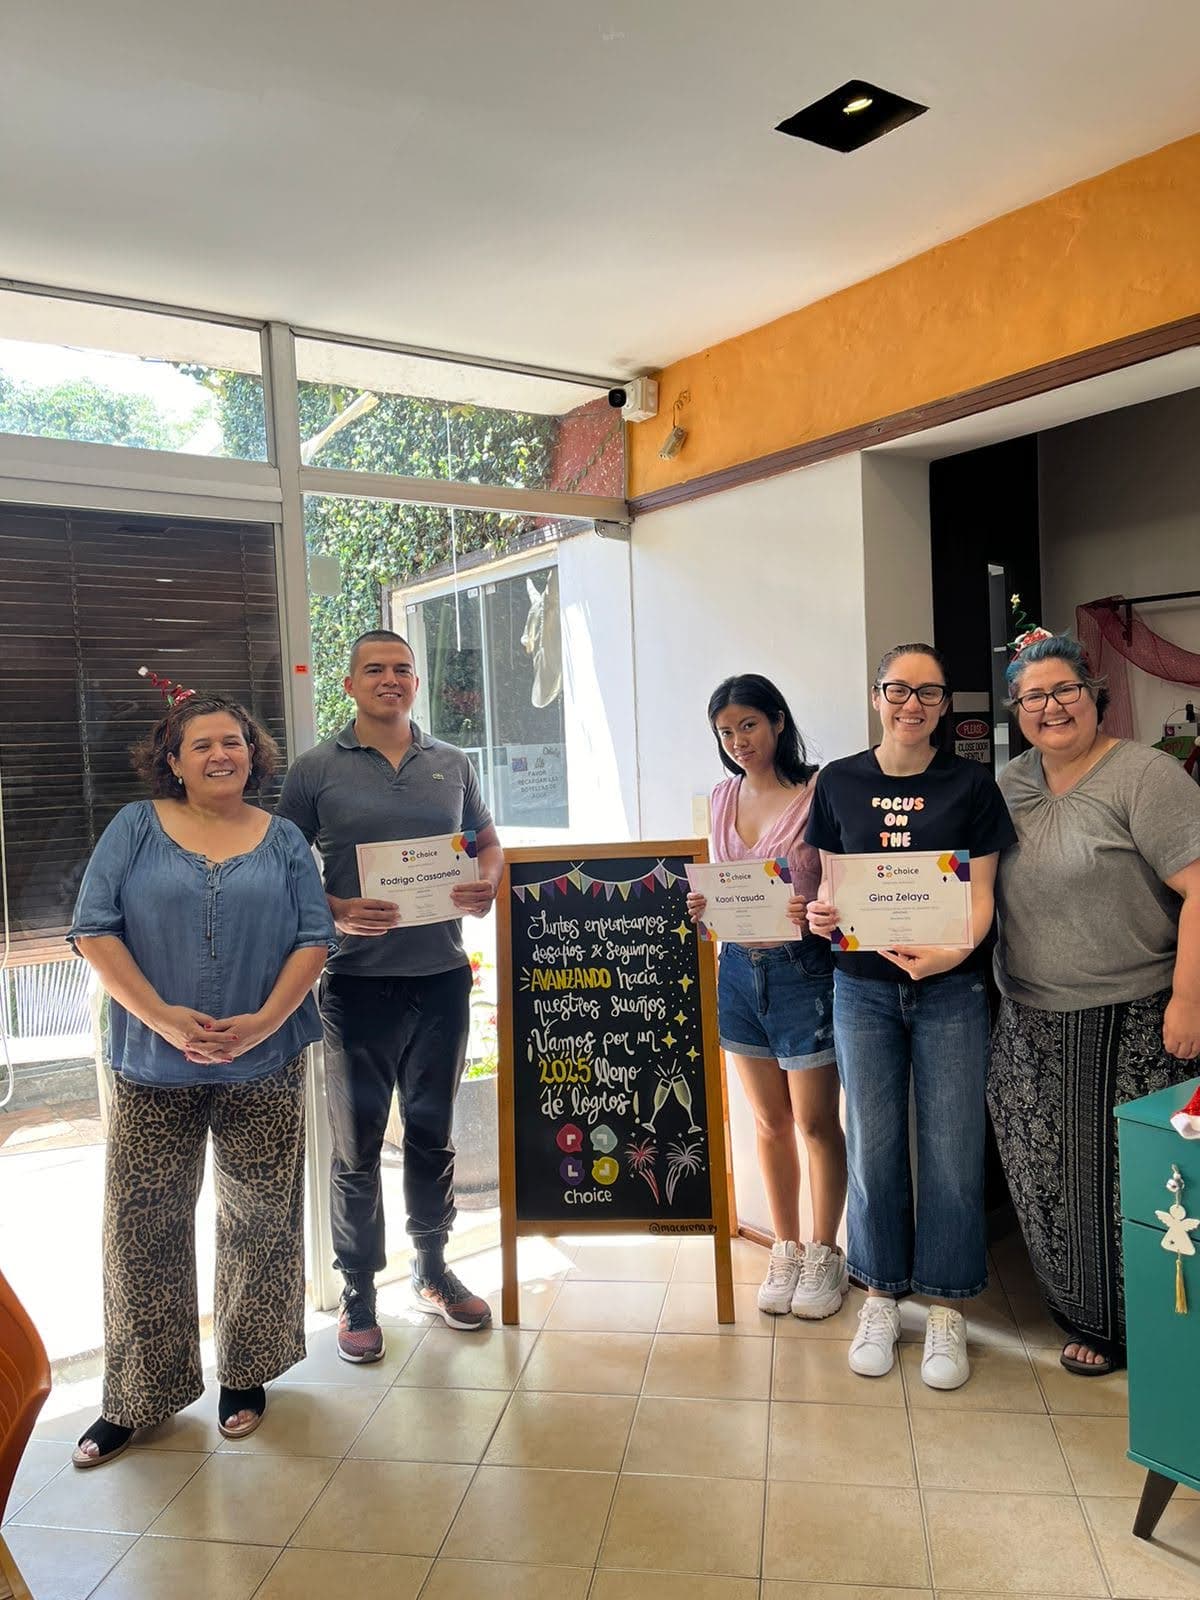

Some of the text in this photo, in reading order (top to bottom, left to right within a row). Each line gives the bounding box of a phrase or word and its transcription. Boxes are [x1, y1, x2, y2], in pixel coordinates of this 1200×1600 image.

[963, 724, 983, 734] PLEASE
[958, 742, 975, 751] CLOSE
[871, 797, 925, 811] FOCUS
[884, 812, 909, 827] ON
[879, 831, 912, 847] THE
[416, 850, 438, 860] choice
[380, 869, 461, 887] Rodrigo Cassanello
[731, 872, 751, 881] choice
[893, 867, 919, 875] choice
[715, 893, 765, 904] Kaori Yasuda
[868, 892, 930, 903] Gina Zelaya
[527, 910, 580, 940] Juntos
[531, 966, 663, 992] AVANZANDO hacia
[533, 991, 666, 1027] nuestros sueños
[527, 1022, 661, 1065] ¡Vamos por un
[539, 1056, 642, 1093] 2025 lleno
[541, 1086, 641, 1125] de logros!
[564, 1187, 612, 1204] choice
